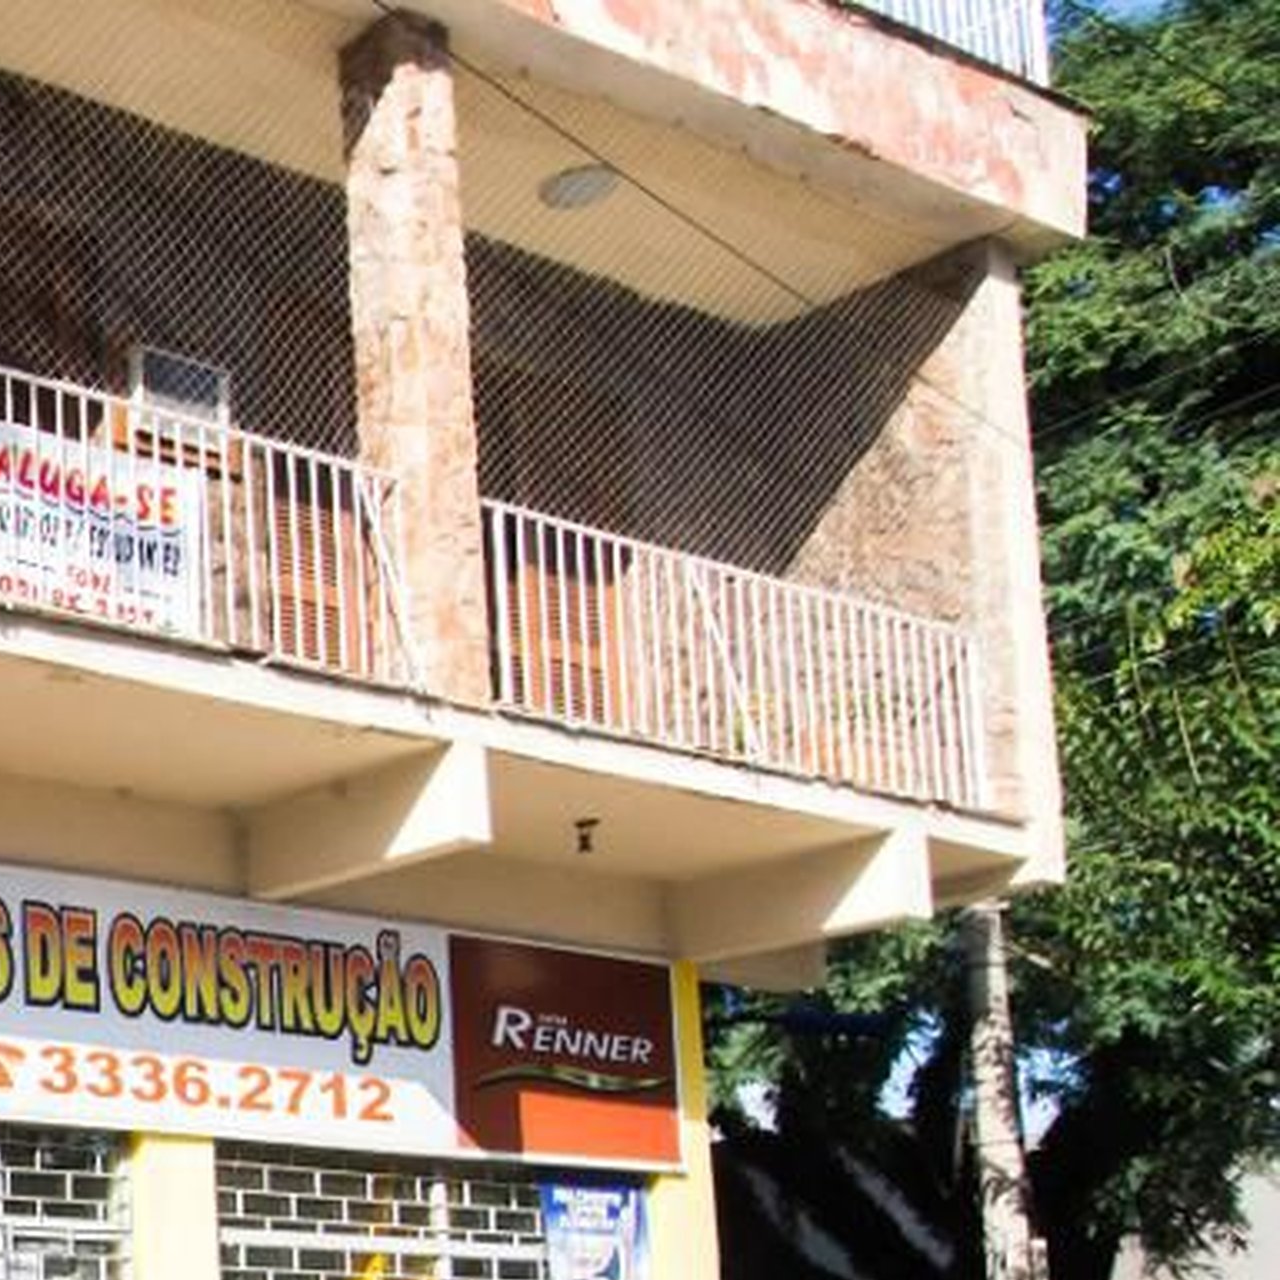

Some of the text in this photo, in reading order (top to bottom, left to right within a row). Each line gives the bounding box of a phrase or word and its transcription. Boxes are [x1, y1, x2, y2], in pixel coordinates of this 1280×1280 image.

[22, 900, 100, 1013] DE
[108, 910, 440, 1066] CONSTRUÇÃO
[493, 1005, 653, 1064] RENNER
[40, 1044, 395, 1122] 3336.2712
